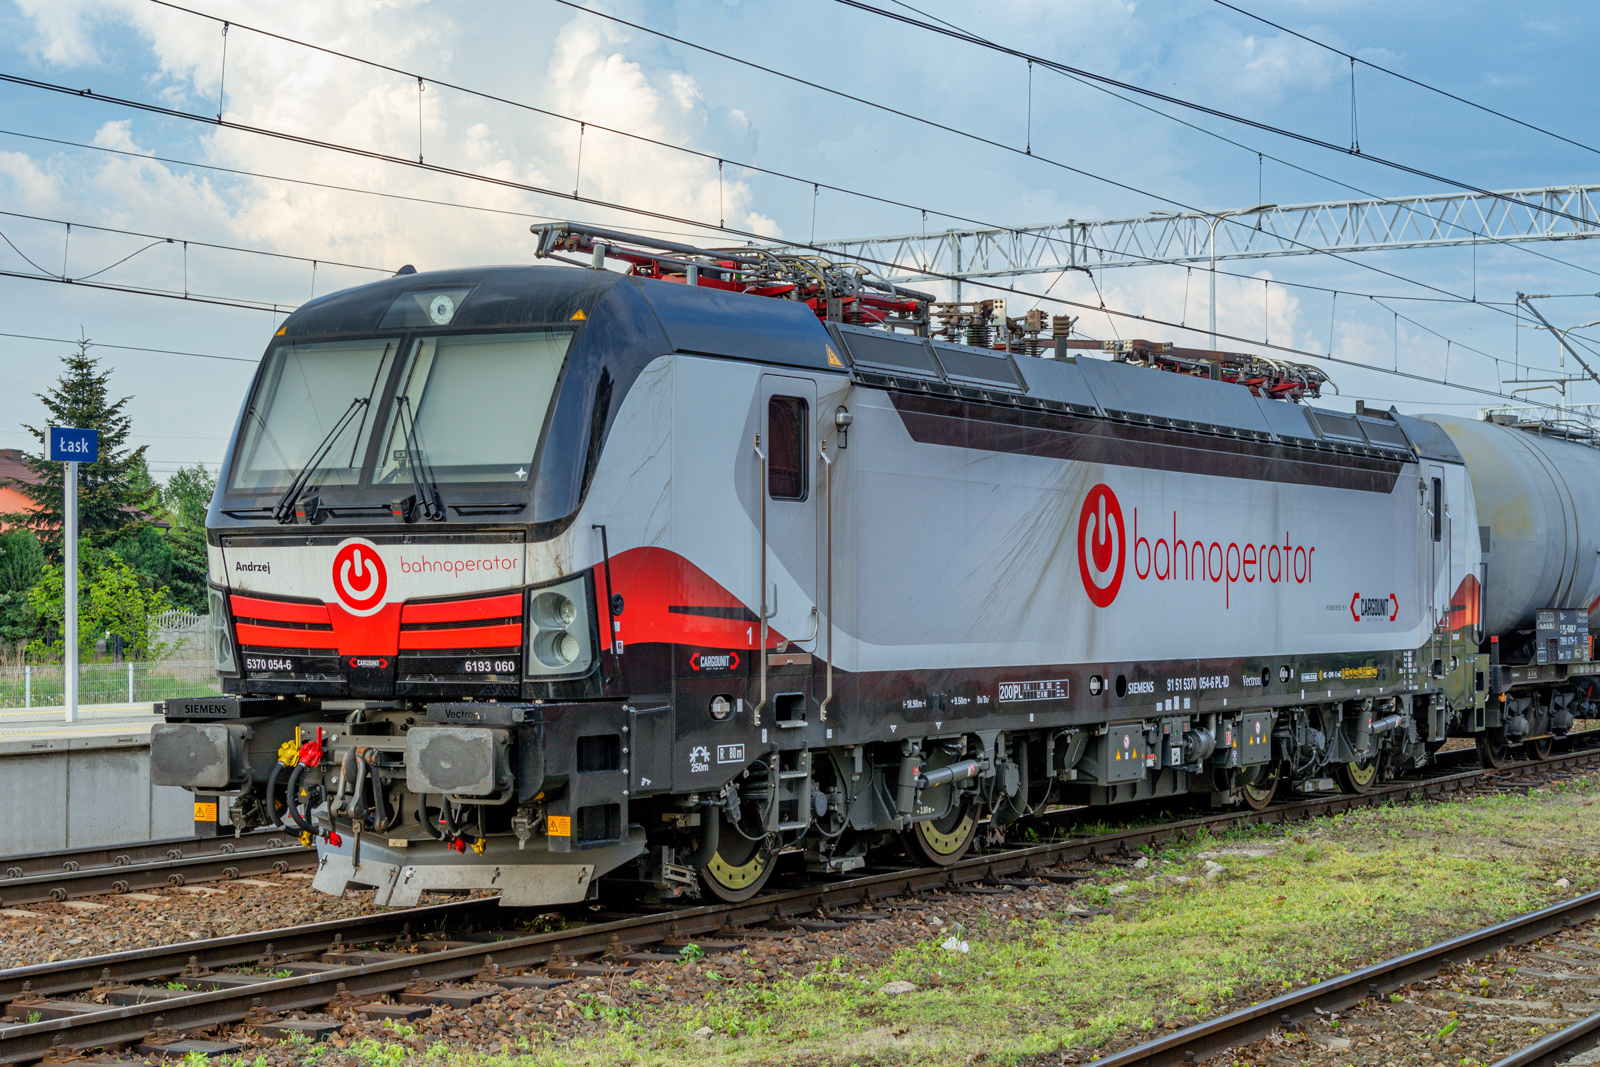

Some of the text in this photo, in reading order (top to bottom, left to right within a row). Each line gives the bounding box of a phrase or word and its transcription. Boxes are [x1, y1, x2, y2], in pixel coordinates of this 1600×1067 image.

[60, 437, 89, 453] Łask
[1134, 507, 1315, 609] bahnoperator
[235, 561, 271, 575] Andrzej
[400, 555, 518, 578] bahnoperator
[1361, 598, 1389, 616] CARGOUNIT
[746, 626, 753, 645] 1
[247, 658, 292, 670] 5370 054-6
[357, 659, 380, 667] CARGOUNIT
[465, 660, 515, 672] 6193 060
[700, 655, 730, 668] CARGOUNIT
[1128, 681, 1155, 695] SIEMENS
[1166, 675, 1230, 692] 91 51 5370 054-6 PL-ID
[1242, 675, 1262, 687] Vectron
[1000, 684, 1013, 700] 200
[1014, 684, 1024, 699] PL
[184, 704, 227, 714] SIEMENS
[719, 747, 725, 760] R
[691, 762, 709, 773] 250m
